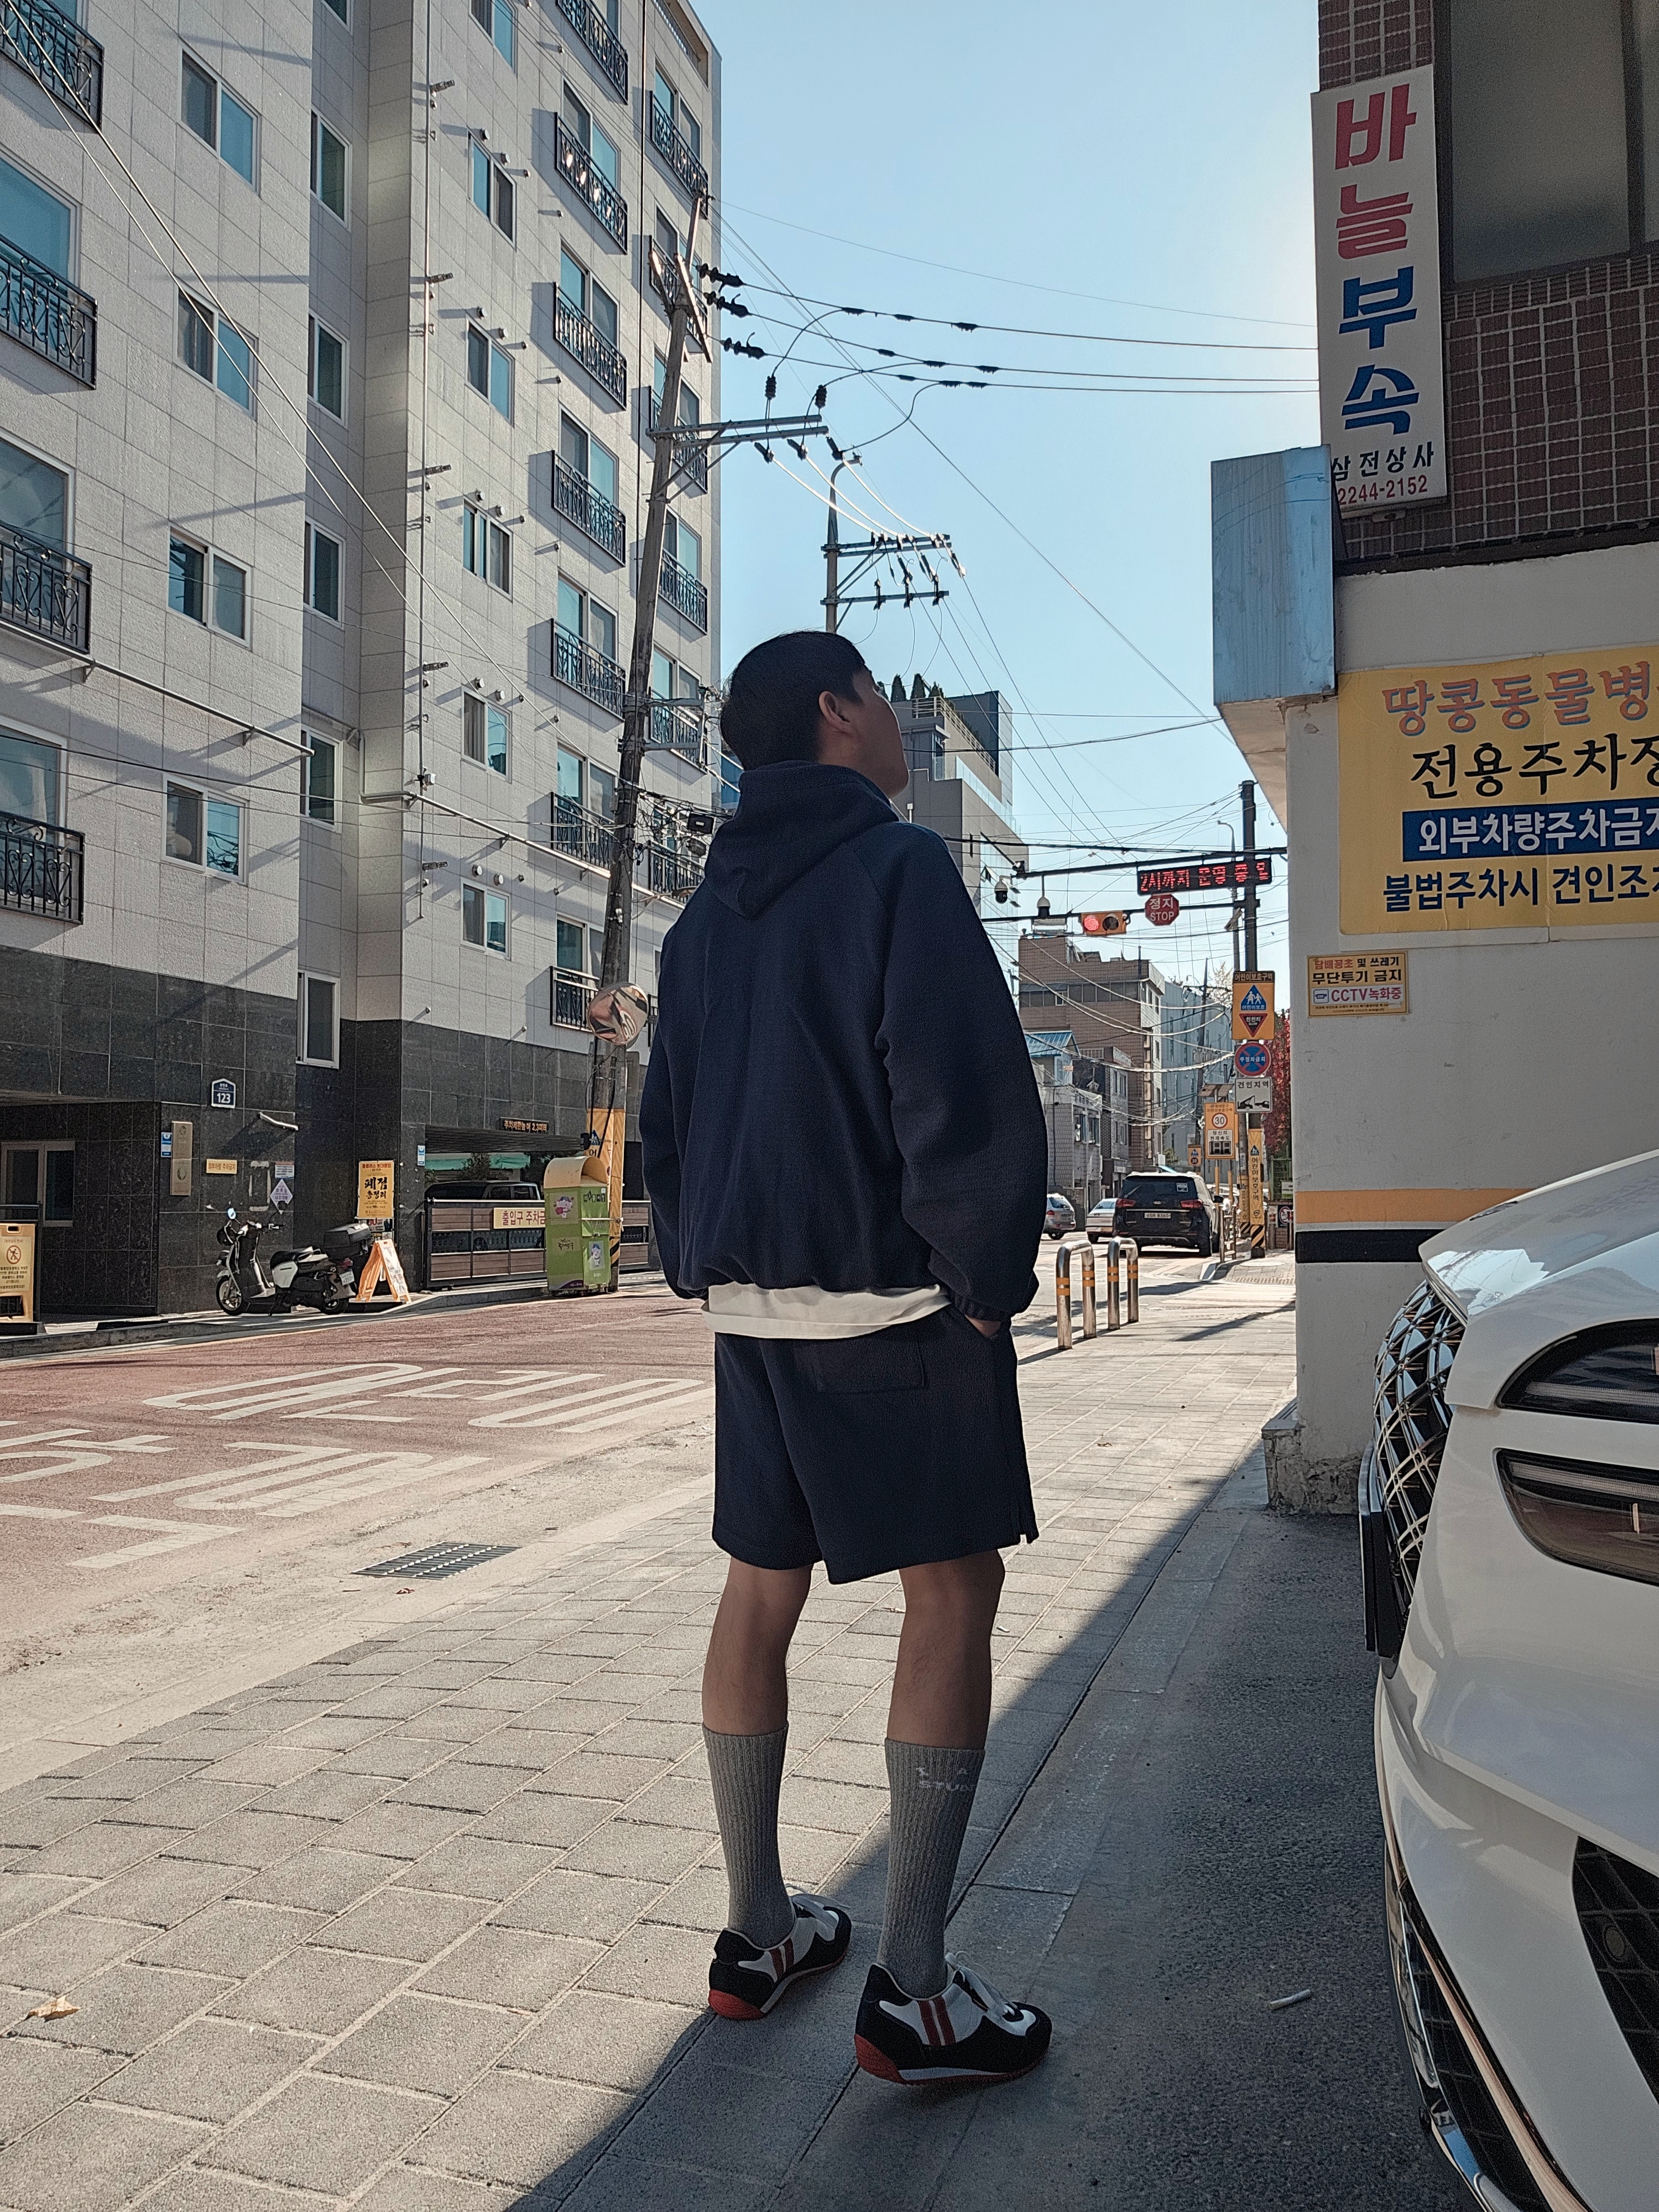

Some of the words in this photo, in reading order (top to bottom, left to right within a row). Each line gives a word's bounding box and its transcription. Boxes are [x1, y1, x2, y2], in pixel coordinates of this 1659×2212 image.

[1334, 83, 1420, 435] 바늘부속
[1332, 441, 1434, 482] 삼전상사
[1337, 474, 1428, 506] 2244-2152
[1382, 660, 1659, 736] 땅콩동물병
[1383, 867, 1538, 912] 불법주차시
[1552, 863, 1659, 905] 견인조
[1149, 896, 1173, 910] 정지
[1150, 911, 1175, 922] STOP
[1314, 958, 1354, 970] 담배꽁초
[1357, 958, 1366, 968] 및
[1370, 956, 1399, 967] 쓰레기
[1234, 973, 1273, 982] 어린이보호구역
[1312, 970, 1368, 985] 무단투기
[1374, 969, 1401, 982] 금지
[1238, 1080, 1269, 1089] 견인지역
[217, 1092, 231, 1104] 123
[1214, 1117, 1225, 1125] 30
[502, 1210, 524, 1226] 출입구
